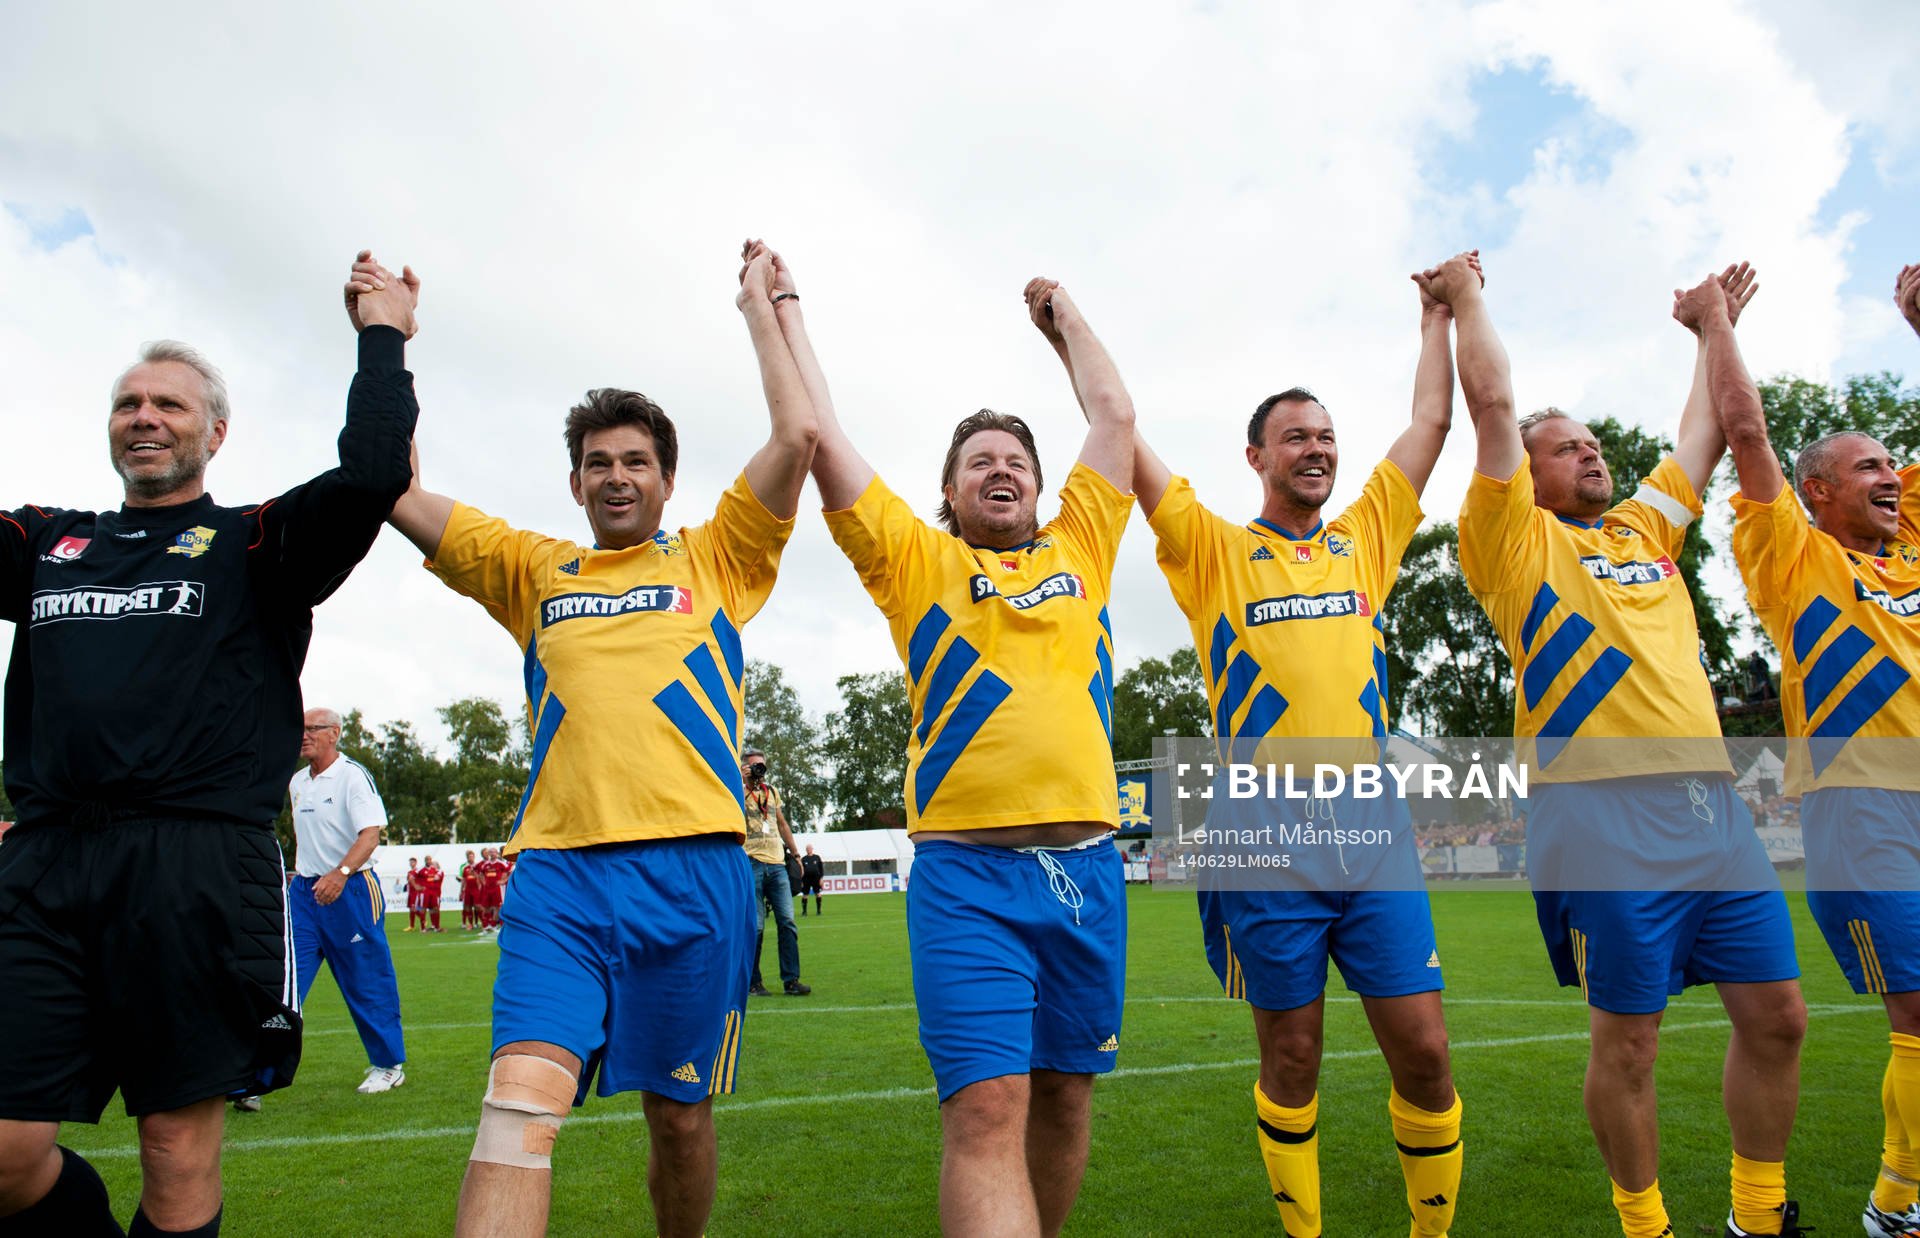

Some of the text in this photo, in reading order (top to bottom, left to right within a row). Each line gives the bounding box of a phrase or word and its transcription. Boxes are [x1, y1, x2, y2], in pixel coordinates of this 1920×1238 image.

[31, 587, 163, 621] STRYKTIPSET
[547, 589, 659, 622] STRYKTIPSET
[1253, 596, 1352, 623] STRYKTIPSET
[823, 880, 884, 890] CRAMO
